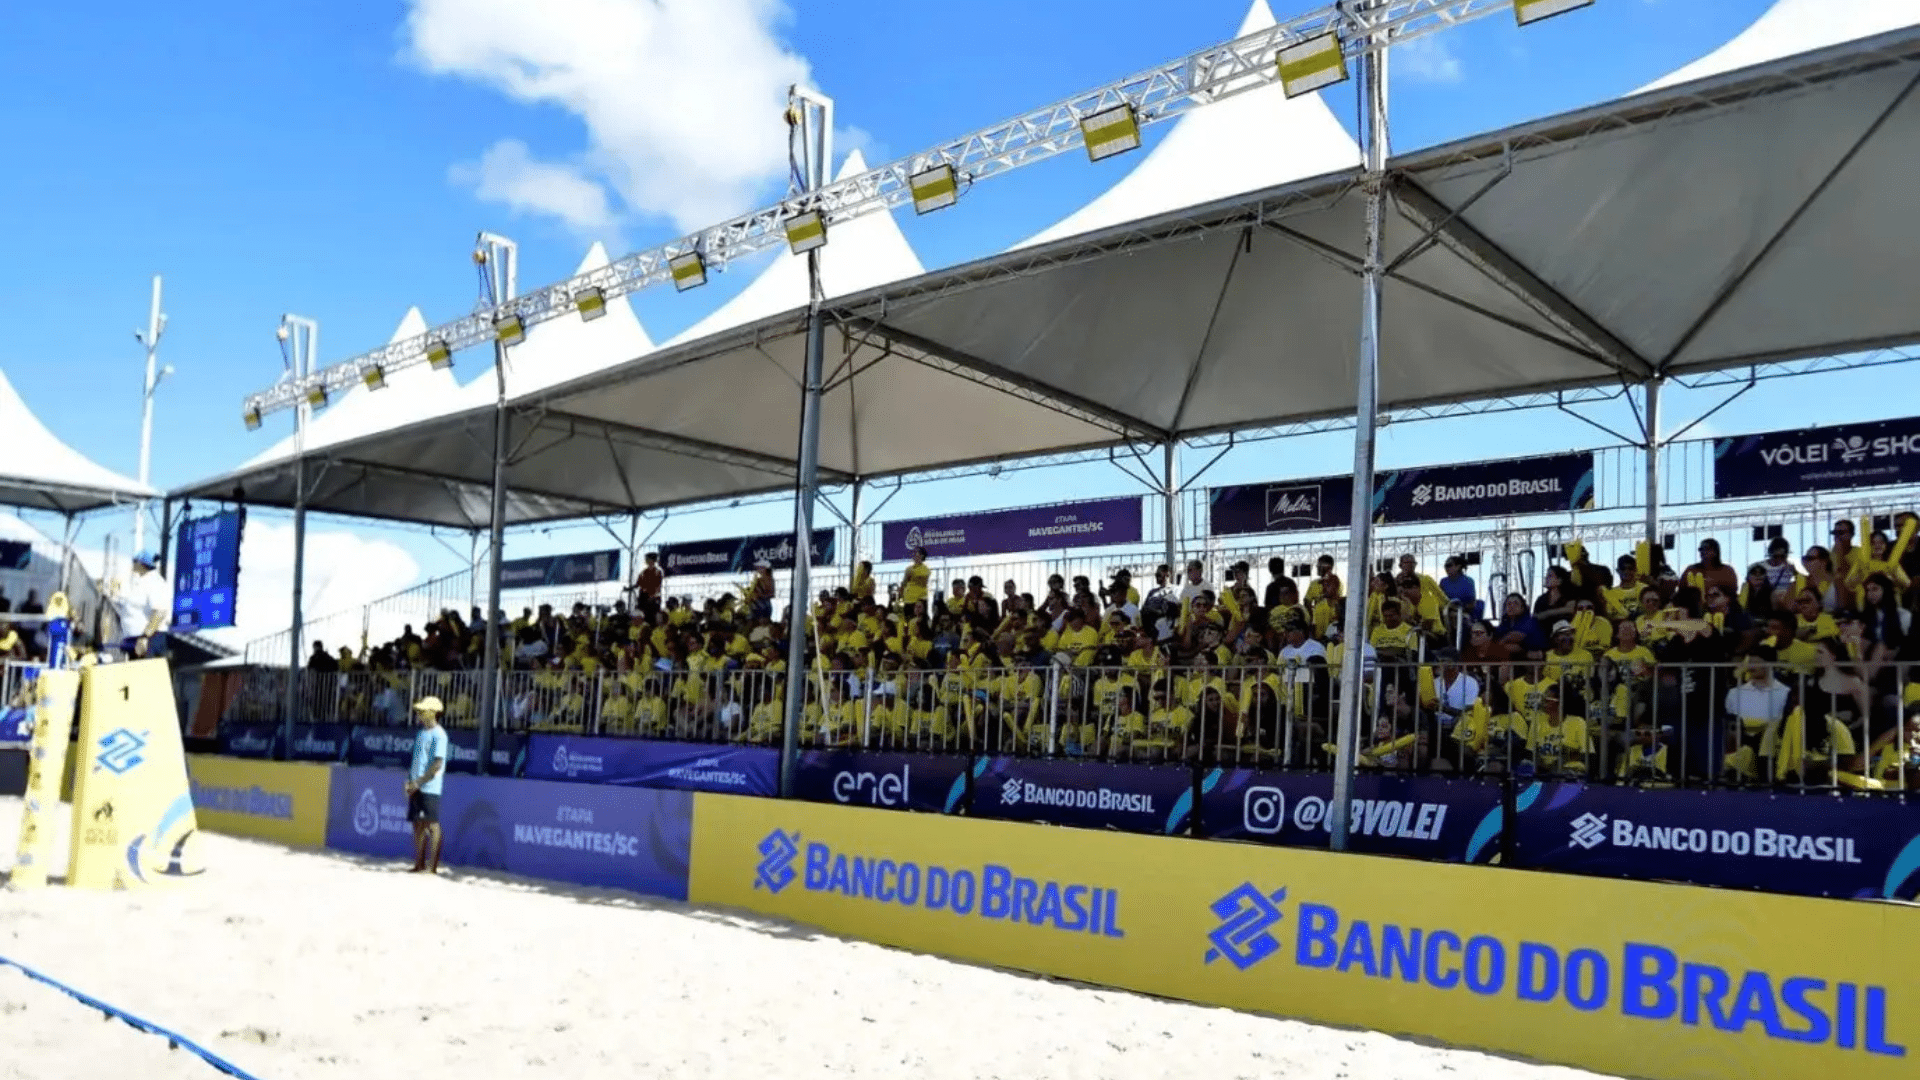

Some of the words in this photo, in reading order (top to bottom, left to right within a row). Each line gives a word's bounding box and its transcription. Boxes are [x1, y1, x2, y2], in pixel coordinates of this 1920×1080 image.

[1435, 486, 1484, 502] BANCO
[1487, 482, 1507, 497] DO
[1508, 478, 1562, 495] BRASIL
[1028, 522, 1104, 537] NAVEGANTES/SC
[119, 685, 129, 701] 1
[834, 764, 909, 805] enel
[1024, 783, 1075, 807] BANCO
[1076, 790, 1097, 809] DO
[1099, 788, 1155, 813] BRASIL
[514, 824, 639, 857] NAVEGANTES/SC
[1612, 820, 1706, 853] BANCO
[1711, 830, 1750, 856] DO
[1754, 828, 1862, 863] BRASIL
[804, 842, 921, 906] BANCO
[925, 866, 975, 916] DO
[980, 864, 1125, 939] BRASIL
[1295, 902, 1507, 995] BANCO
[1516, 941, 1611, 1012] DO
[1620, 942, 1907, 1058] BRASIL
